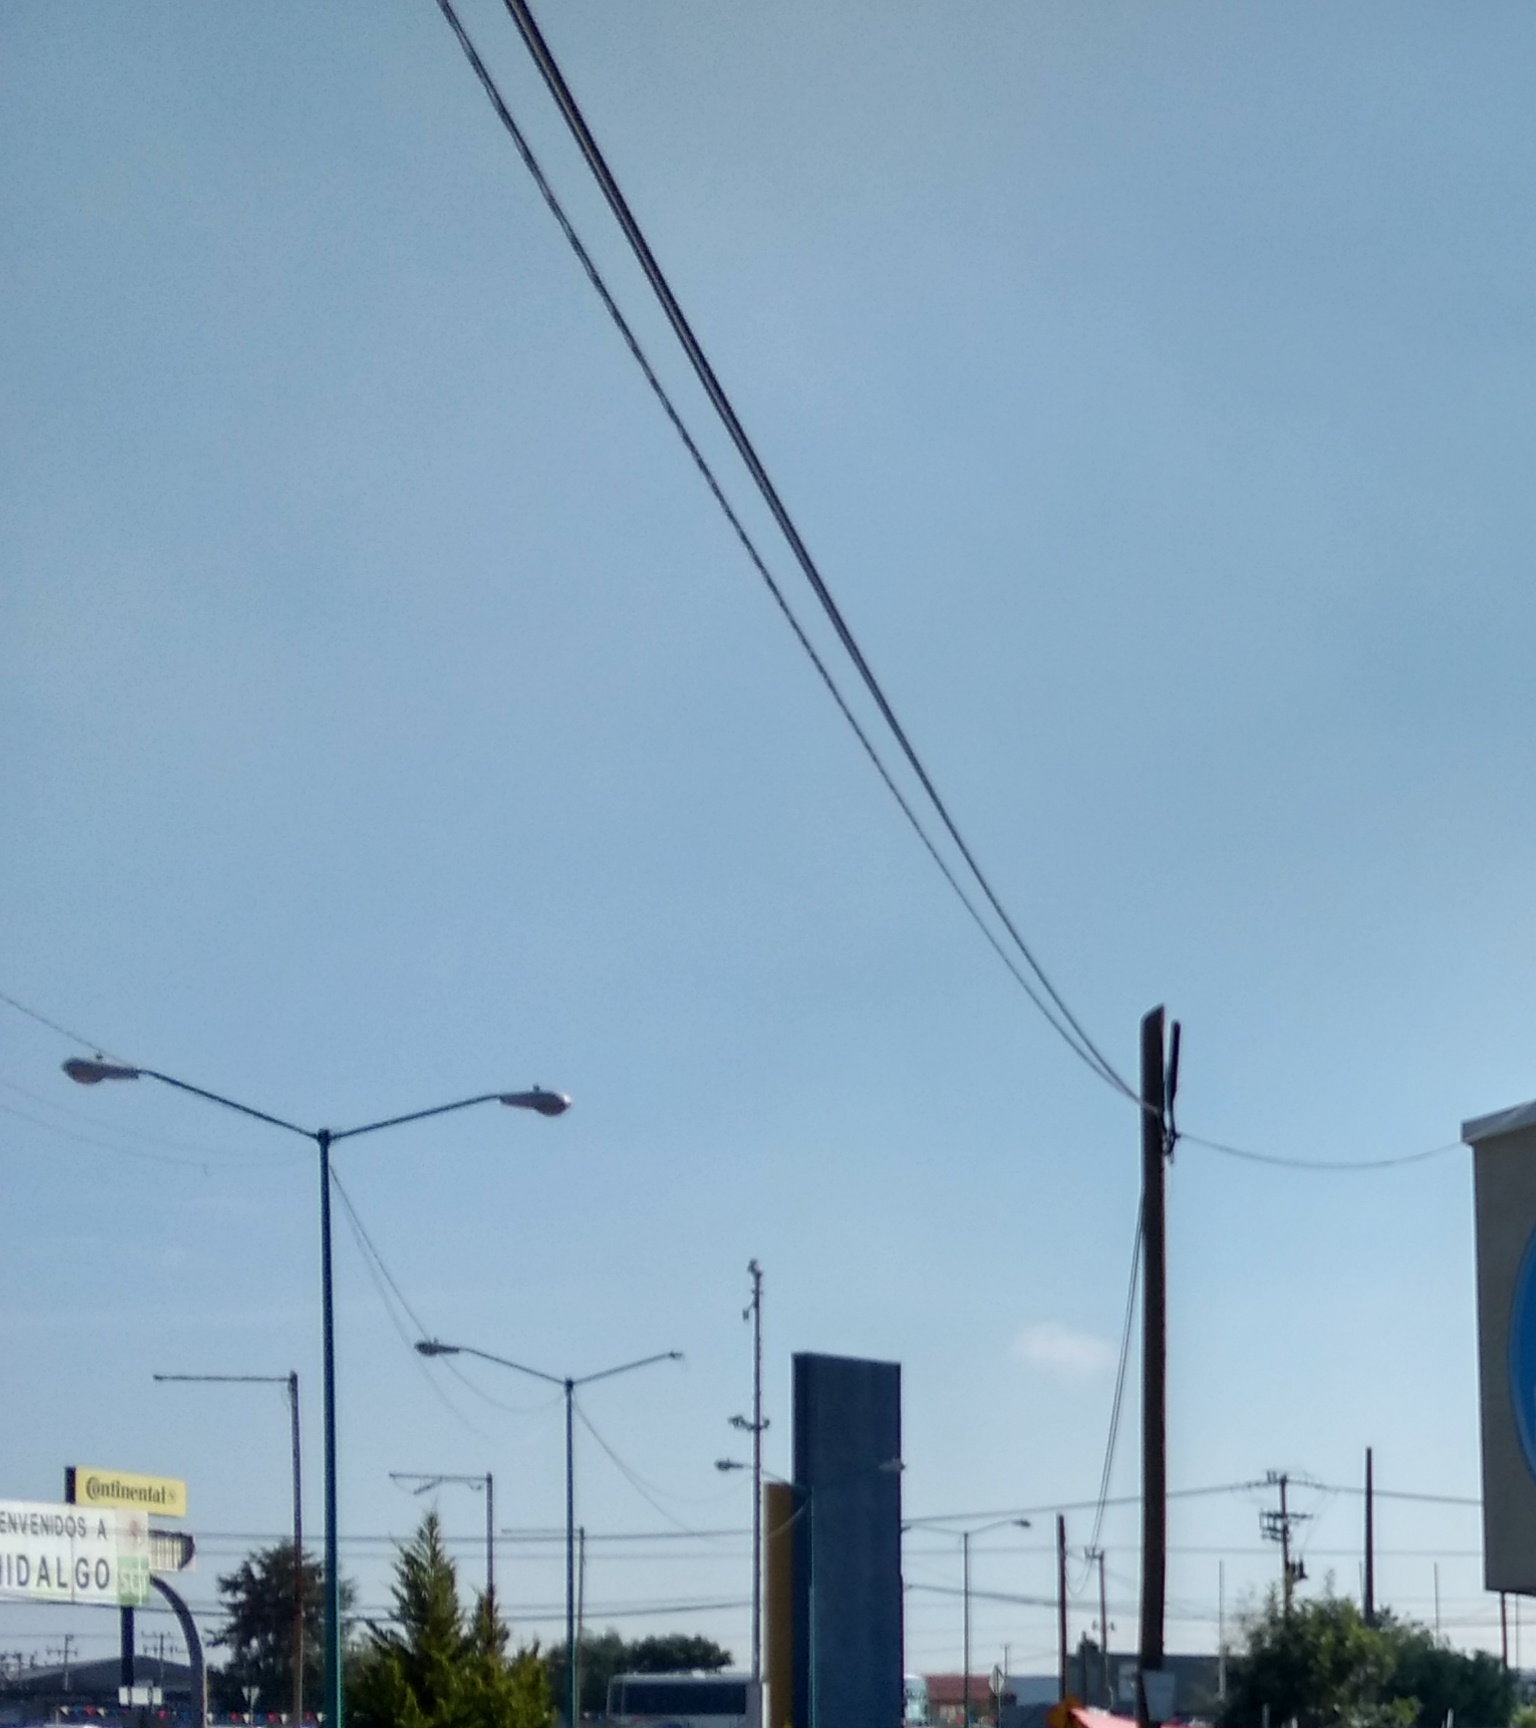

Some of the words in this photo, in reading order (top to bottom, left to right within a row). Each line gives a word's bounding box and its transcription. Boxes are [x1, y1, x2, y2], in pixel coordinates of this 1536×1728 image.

[86, 1476, 166, 1504] Continental
[97, 1518, 108, 1540] A
[0, 1553, 110, 1590] IDALGO
